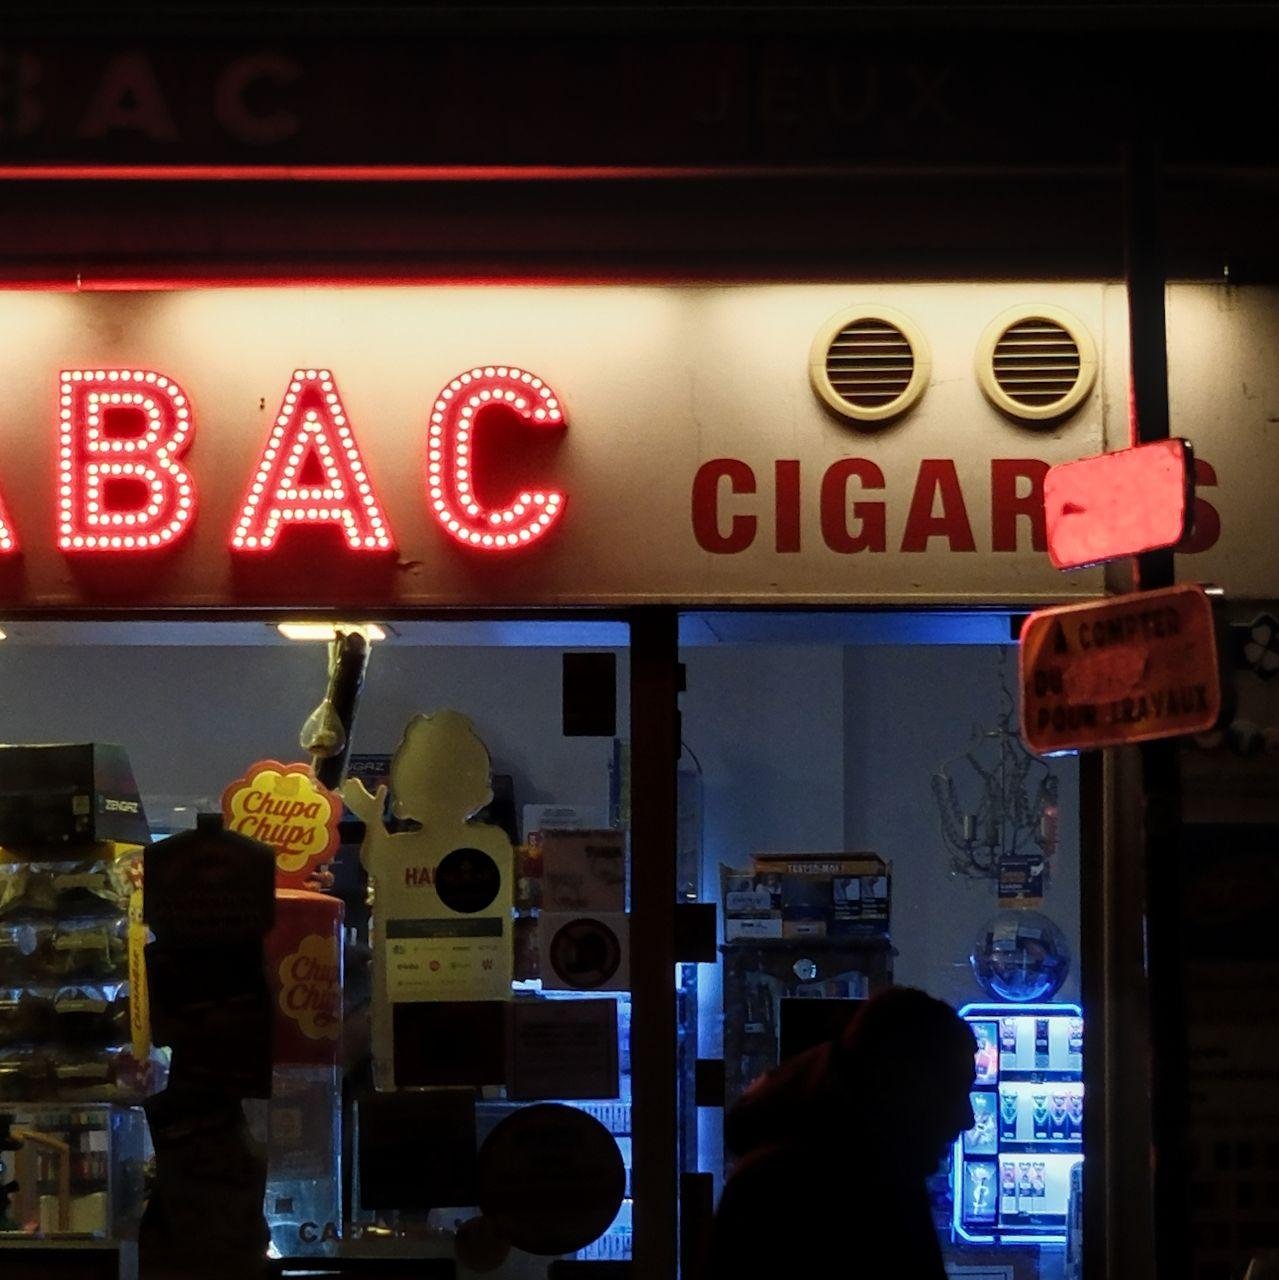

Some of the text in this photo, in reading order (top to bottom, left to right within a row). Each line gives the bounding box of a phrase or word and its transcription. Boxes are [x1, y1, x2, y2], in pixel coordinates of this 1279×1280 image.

[690, 457, 1221, 555] CIGARS
[1036, 704, 1097, 733] POUR
[242, 790, 321, 824] Chupa
[236, 814, 315, 848] Chups
